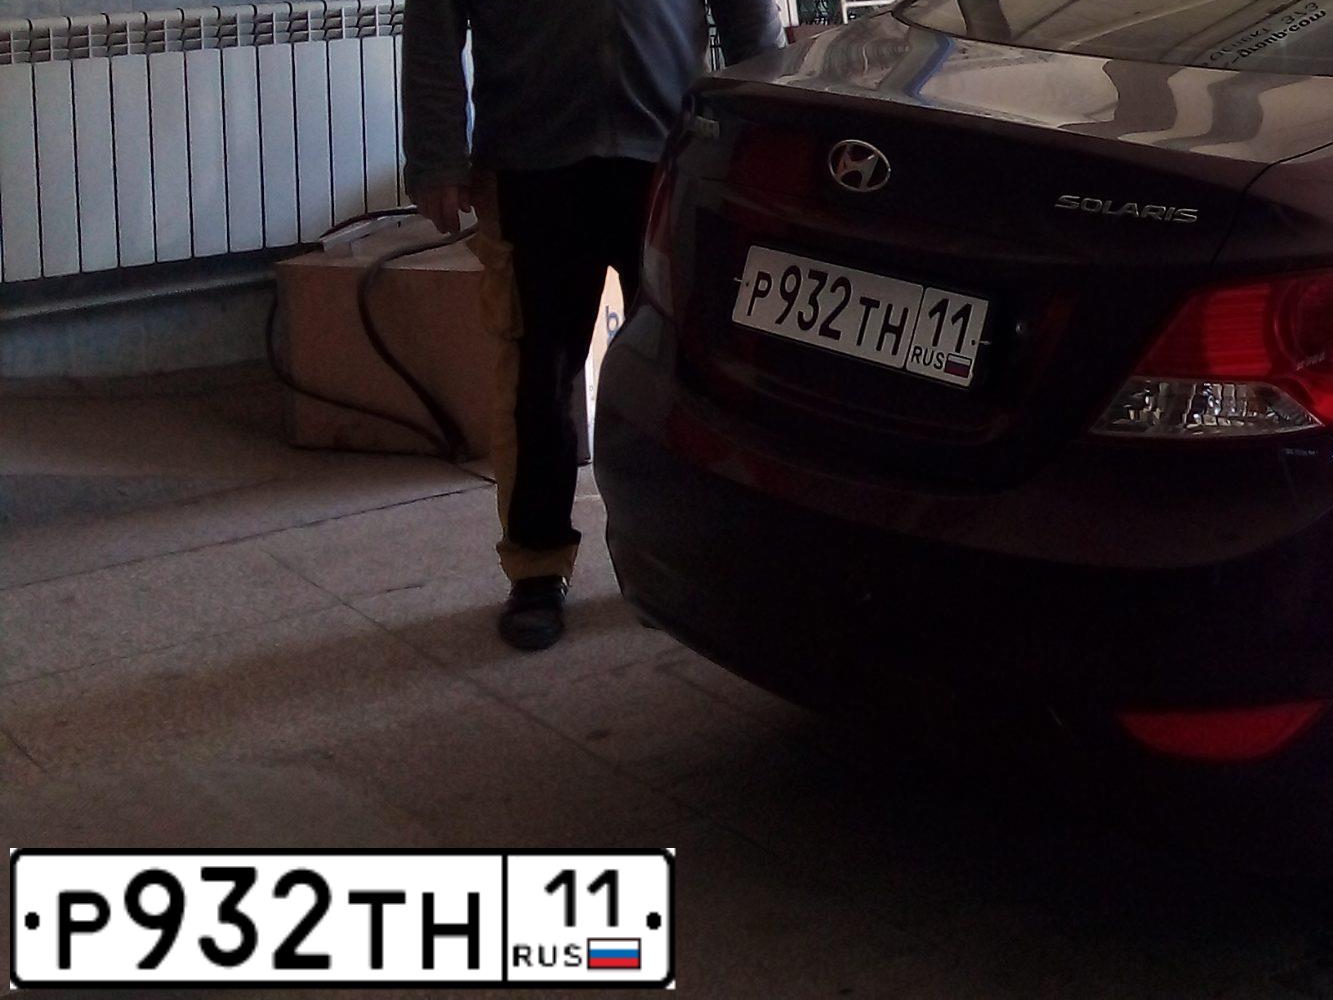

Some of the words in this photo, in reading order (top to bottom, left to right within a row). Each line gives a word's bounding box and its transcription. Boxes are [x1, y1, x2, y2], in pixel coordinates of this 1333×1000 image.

[1054, 194, 1199, 223] SOLARIS
[928, 297, 973, 354] 11
[910, 345, 946, 371] RUS
